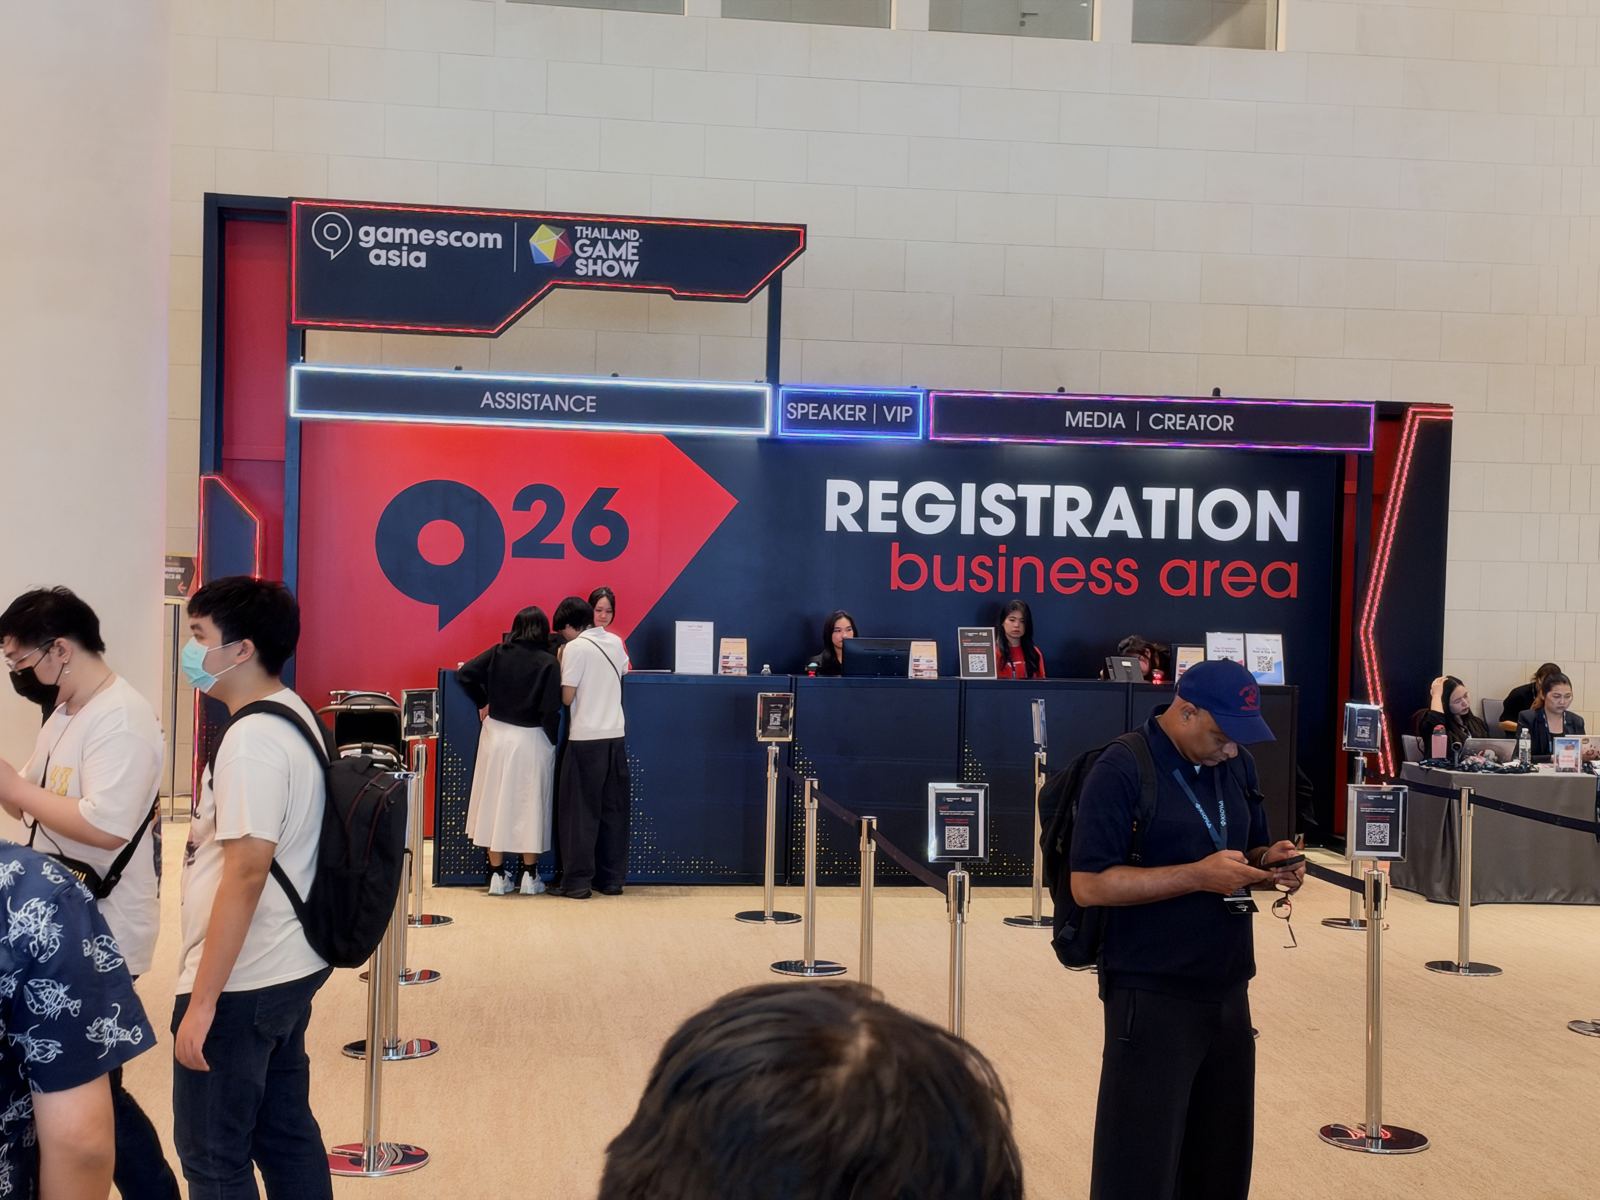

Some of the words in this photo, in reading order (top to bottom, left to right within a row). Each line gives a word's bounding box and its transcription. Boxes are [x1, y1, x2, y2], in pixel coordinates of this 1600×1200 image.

[358, 225, 503, 249] gamescom
[574, 225, 641, 241] THAILAND
[368, 246, 427, 268] asia
[574, 240, 640, 261] GAME
[574, 259, 640, 279] SHOW
[480, 391, 597, 413] ASSISTANCE
[786, 402, 867, 421] SPEAKER
[882, 405, 913, 423] VIP
[1065, 410, 1126, 429] MEDIA
[1148, 412, 1235, 432] CREATOR
[825, 478, 1300, 542] REGISTRATION
[890, 542, 1139, 597] business
[1159, 559, 1299, 599] area
